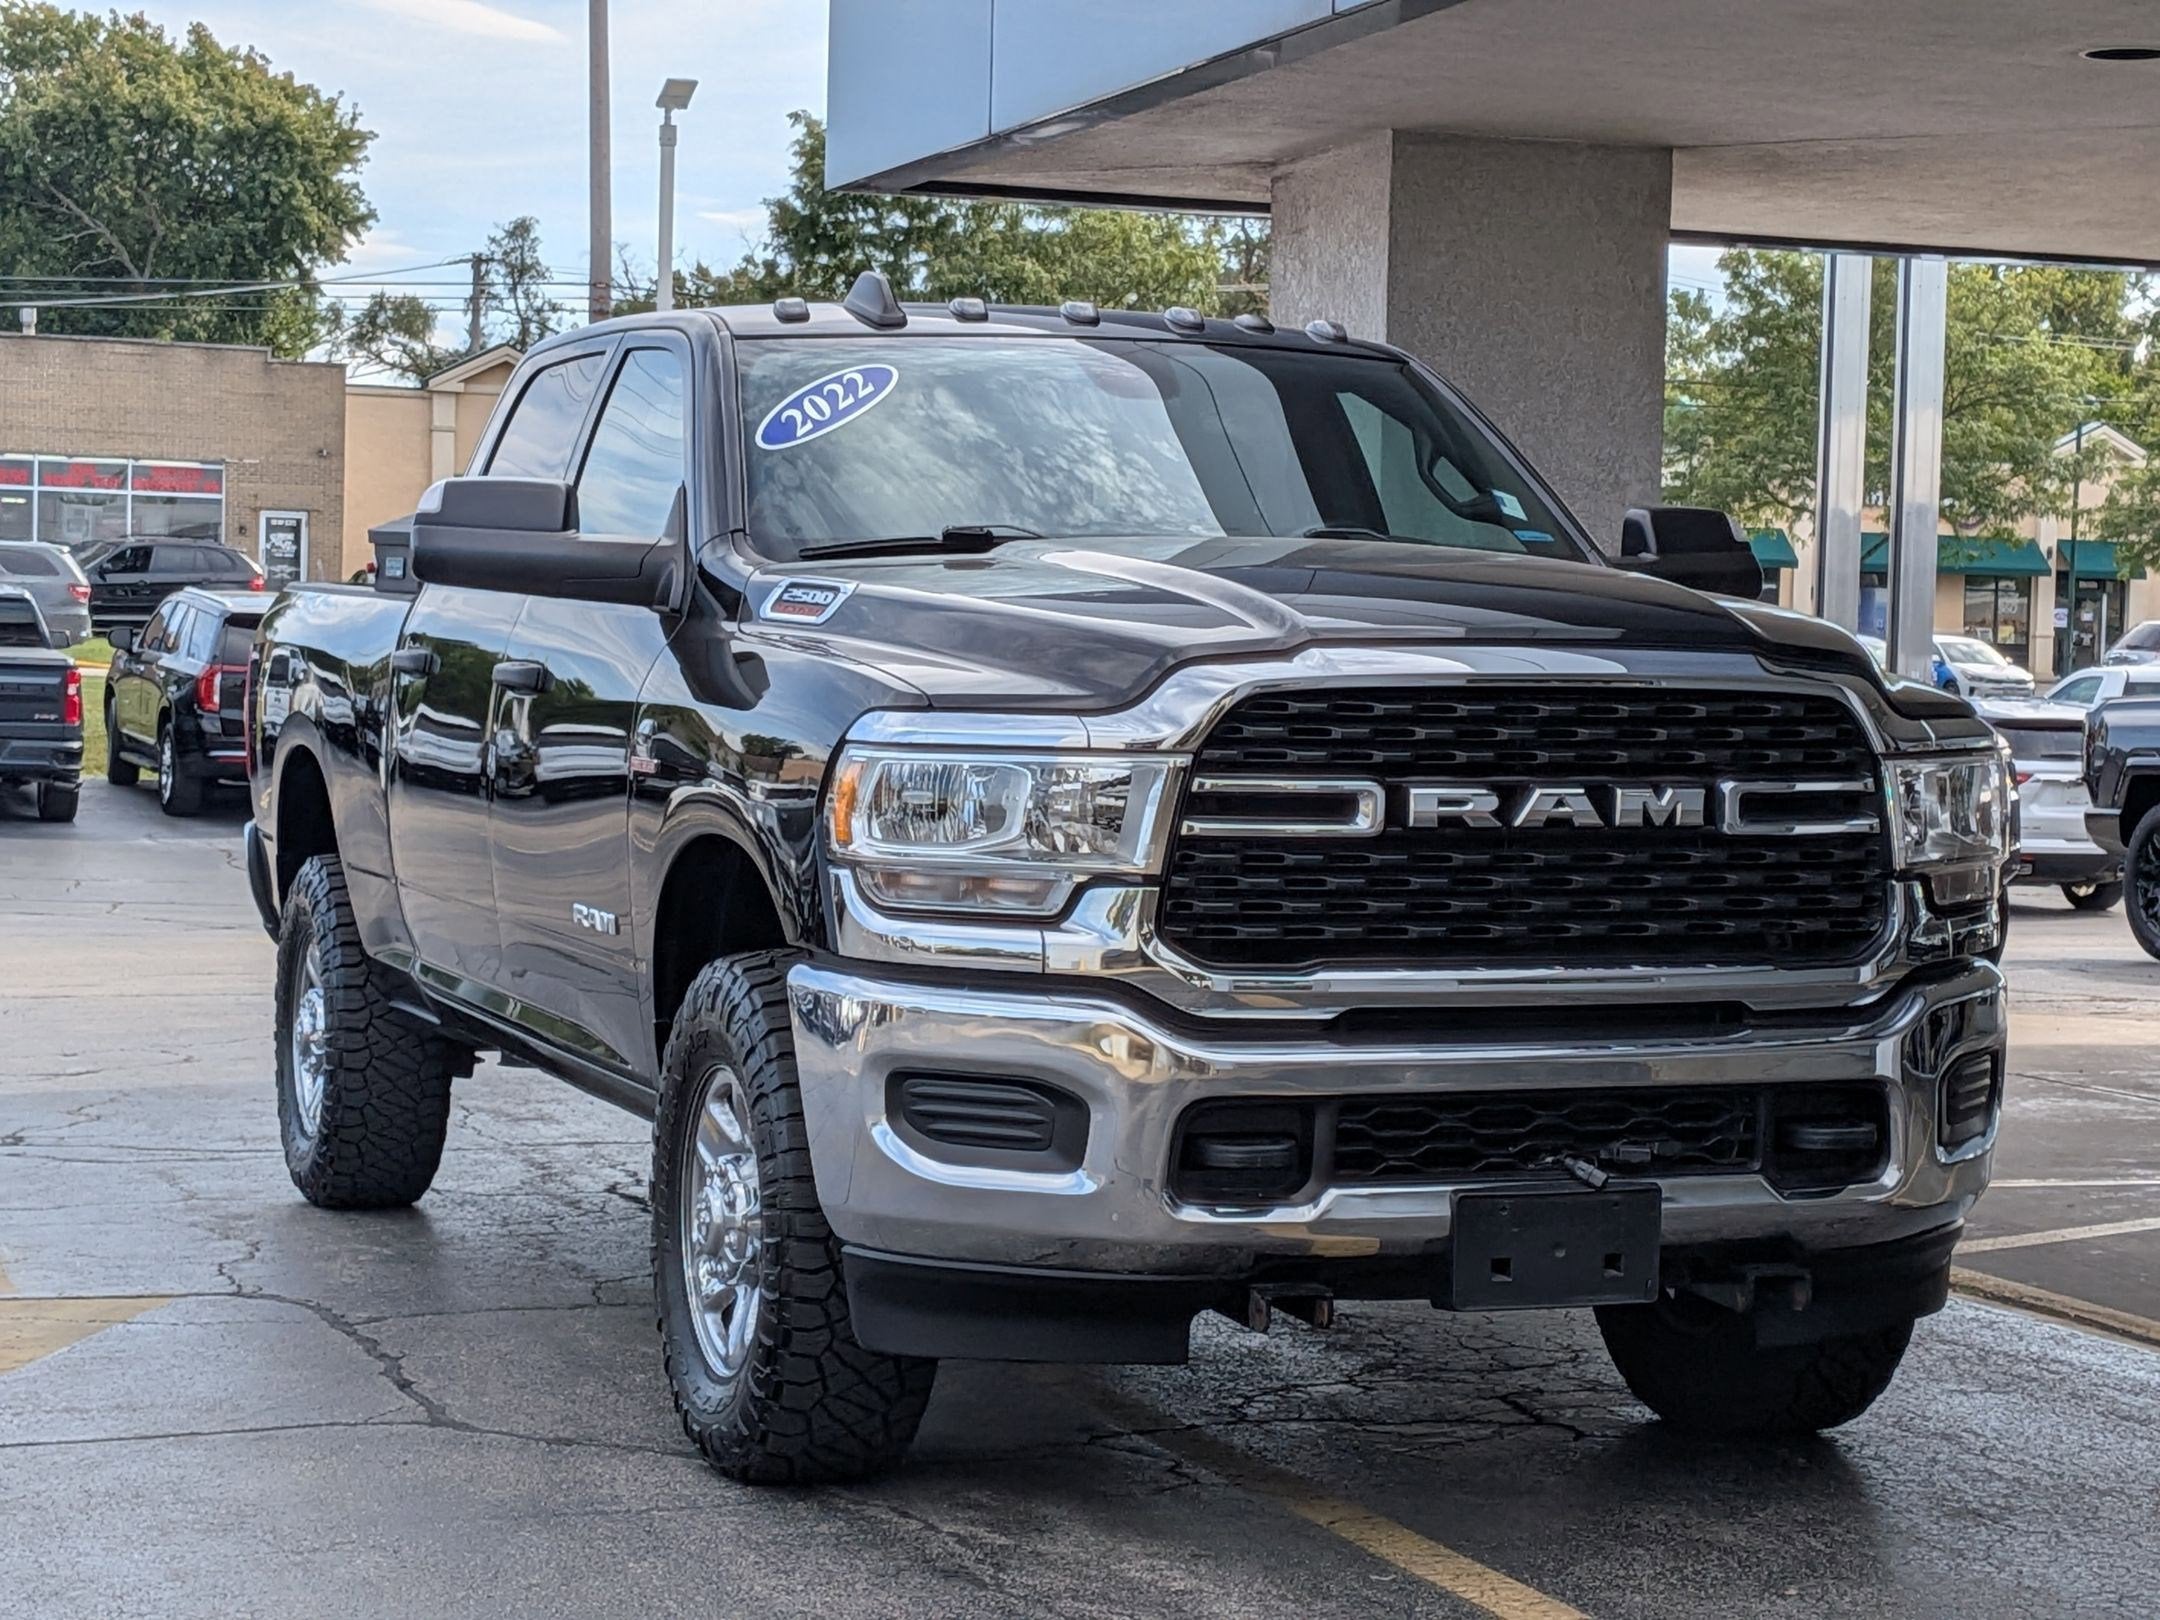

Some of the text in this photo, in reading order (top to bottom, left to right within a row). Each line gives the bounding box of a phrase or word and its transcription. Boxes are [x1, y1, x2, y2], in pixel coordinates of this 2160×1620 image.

[780, 372, 875, 438] 2022
[782, 588, 836, 605] 2500
[1408, 786, 1706, 828] RAM
[572, 902, 618, 936] RAM
